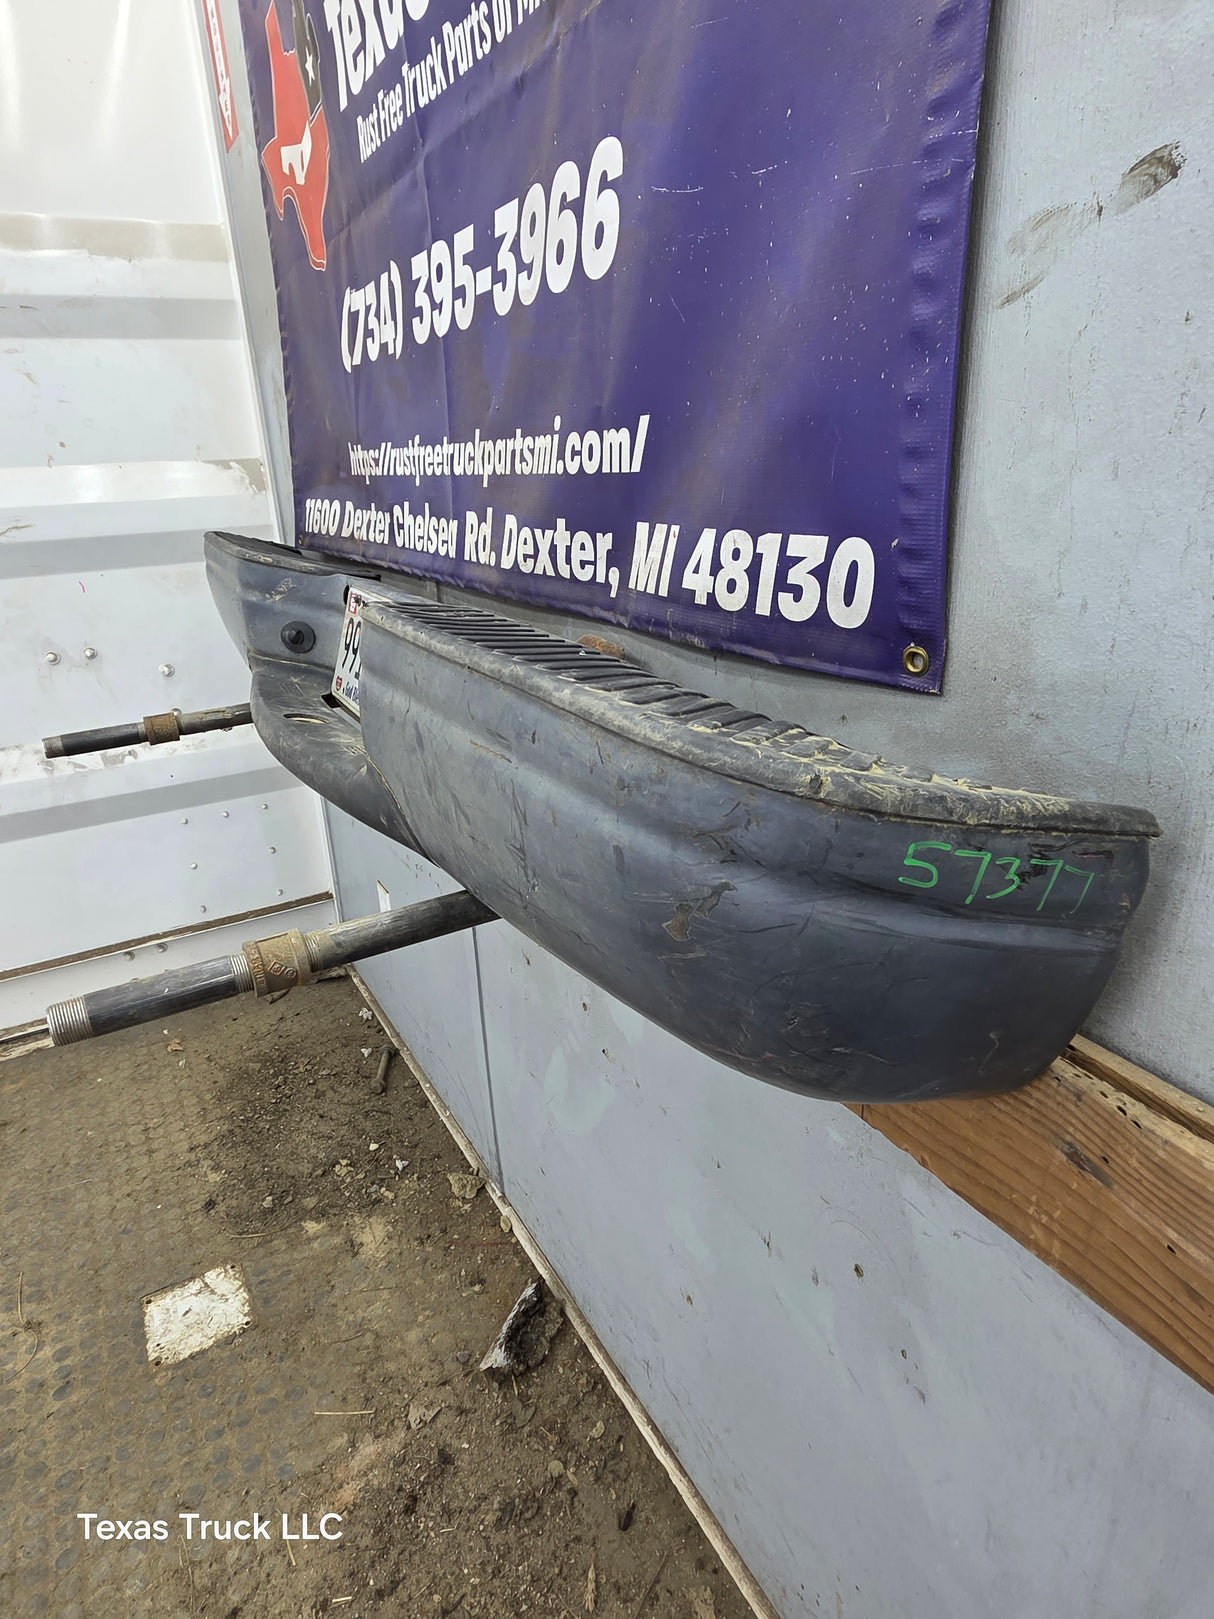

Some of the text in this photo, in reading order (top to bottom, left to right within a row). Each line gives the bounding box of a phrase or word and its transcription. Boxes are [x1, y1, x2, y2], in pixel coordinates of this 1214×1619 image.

[357, 115, 381, 163] Rust
[378, 83, 403, 142] Free
[401, 36, 447, 118] Truck
[442, 0, 492, 84] Parts
[341, 137, 624, 373] (734) 395-3966
[348, 415, 651, 487] https://rustfreetruckpartsmi.com/
[304, 497, 876, 629] 11600 Dexter Chelsea Rd. Dexter, MI 48130
[898, 841, 1095, 913] 57377
